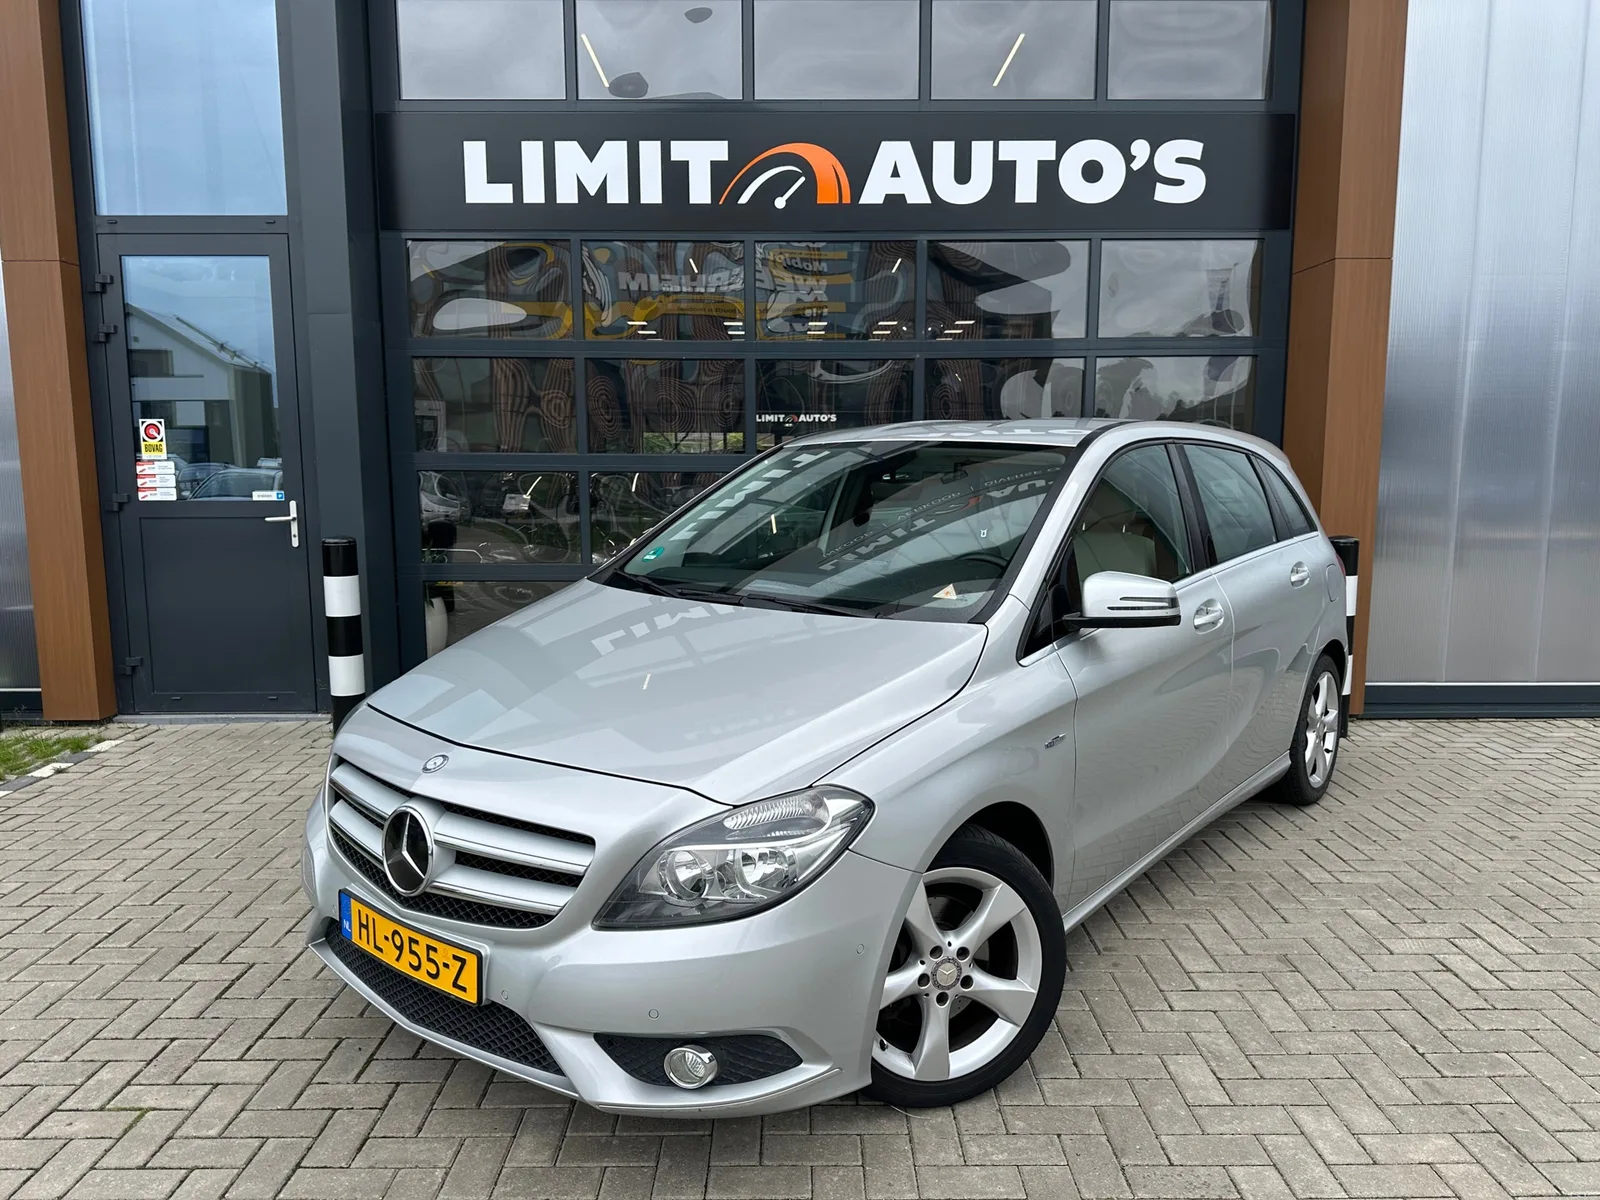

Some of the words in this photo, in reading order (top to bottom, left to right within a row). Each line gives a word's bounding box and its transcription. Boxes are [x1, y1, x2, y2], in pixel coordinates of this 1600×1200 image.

[463, 139, 728, 205] LIMIT
[858, 138, 1207, 205] AUTO'S
[755, 413, 786, 423] LIMIT
[798, 413, 837, 423] AUTO'S
[144, 443, 163, 453] BOVAG
[343, 918, 352, 932] NL
[357, 908, 468, 994] HL-955-Z
